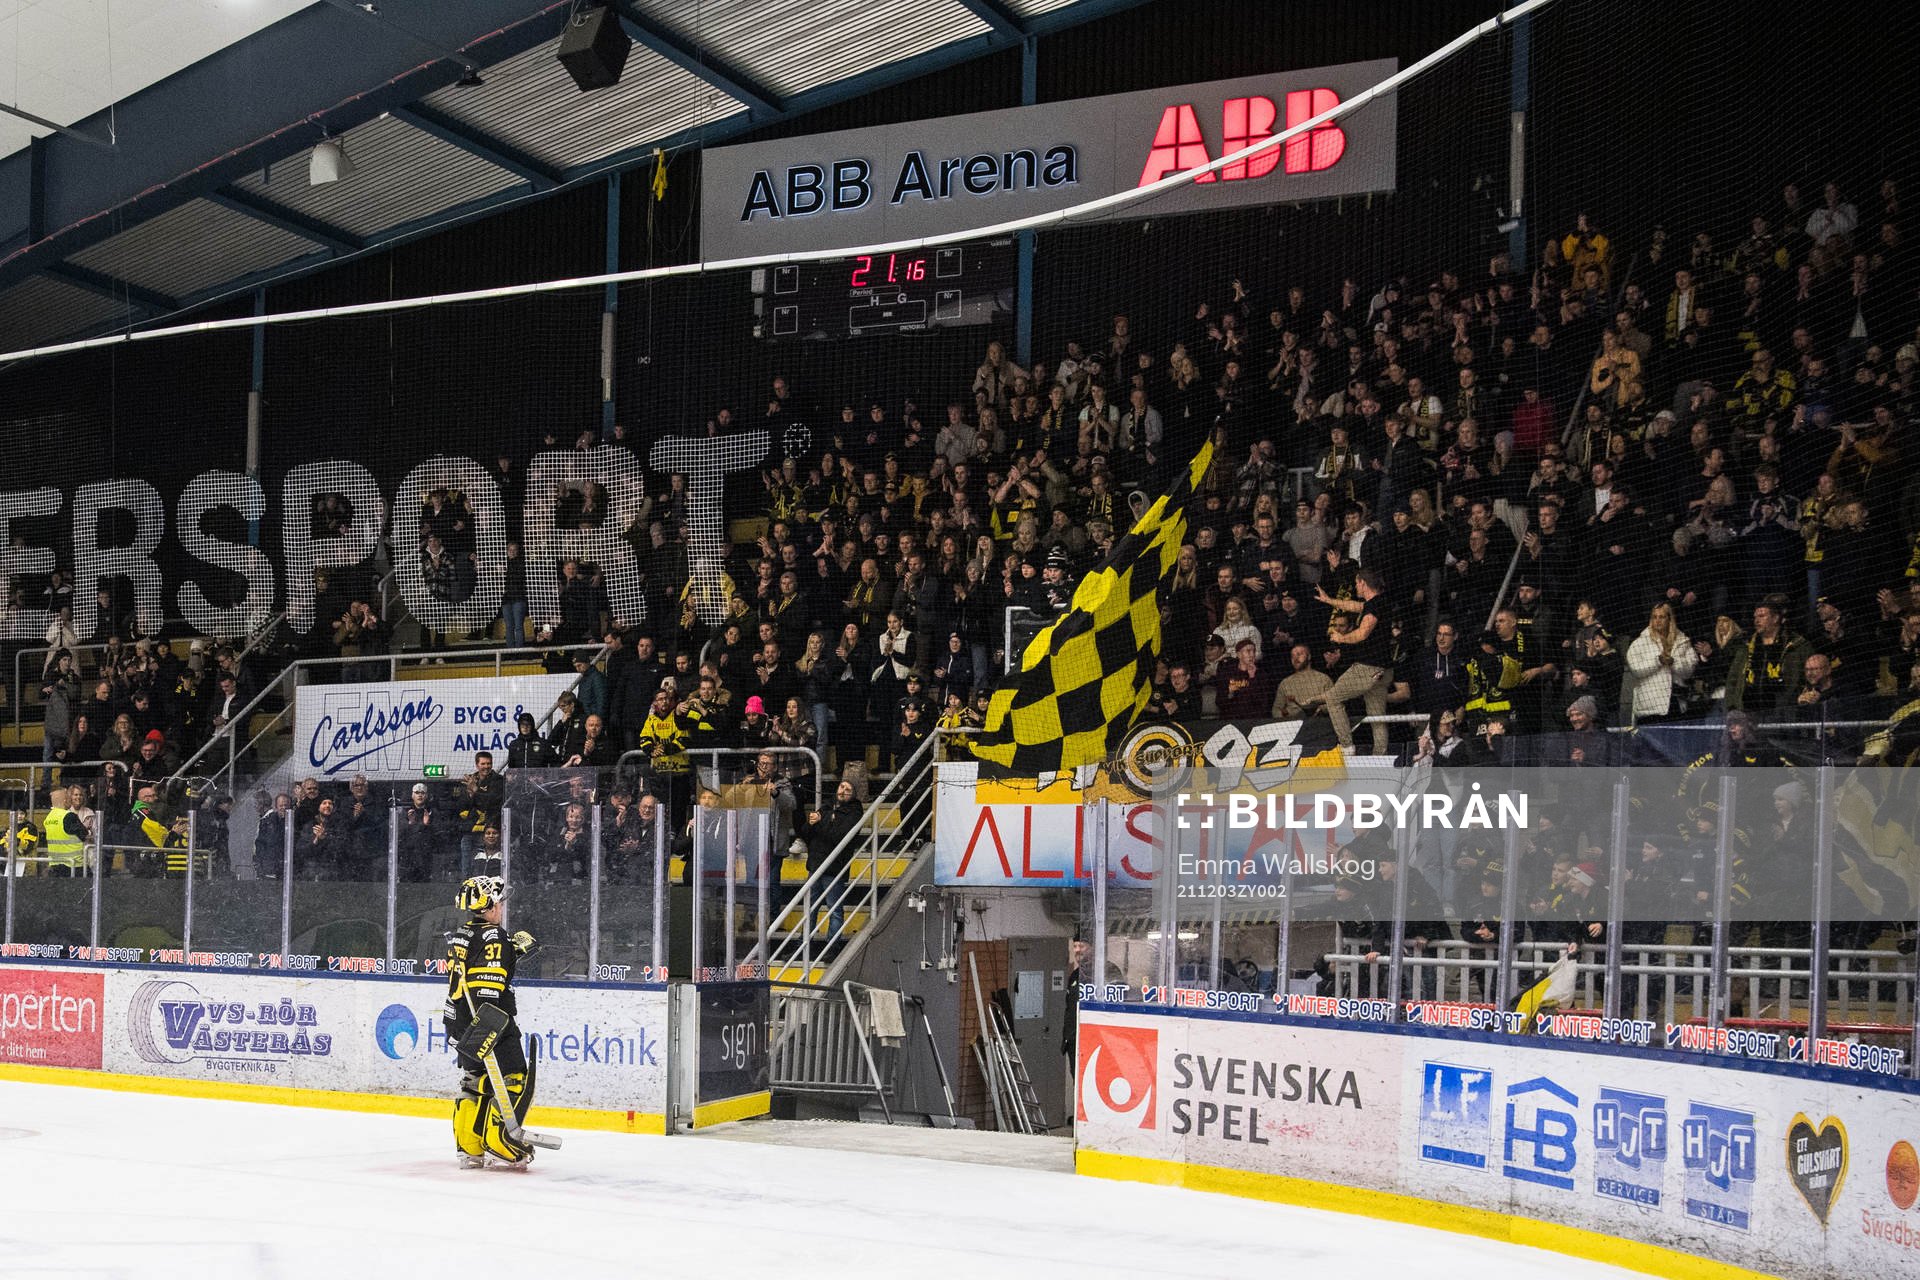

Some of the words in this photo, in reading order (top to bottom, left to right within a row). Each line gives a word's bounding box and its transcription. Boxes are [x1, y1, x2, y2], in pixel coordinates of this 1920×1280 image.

[1137, 87, 1347, 189] ABB
[740, 158, 871, 222] ABB
[891, 142, 1079, 206] Arena
[852, 289, 873, 297] Period
[870, 297, 879, 306] H
[897, 293, 907, 303] G
[454, 704, 506, 724] BYGG
[309, 696, 440, 768] Carlsson
[1203, 719, 1304, 793] 93
[484, 943, 502, 960] 37
[721, 1009, 756, 1070] sign
[1553, 1014, 1652, 1045] INTERSPORT
[1681, 1026, 1778, 1058] INTERSPORT
[7, 1041, 24, 1057] ditt
[26, 1042, 47, 1059] hem
[206, 1060, 262, 1072] BYGGTEKNIK
[264, 1062, 276, 1073] AB
[1172, 1053, 1363, 1110] SVENSKA
[1171, 1098, 1270, 1146] SPEL
[1503, 1102, 1578, 1173] HB
[1797, 1147, 1841, 1175] GULSVART
[1601, 1180, 1654, 1204] SERVICE
